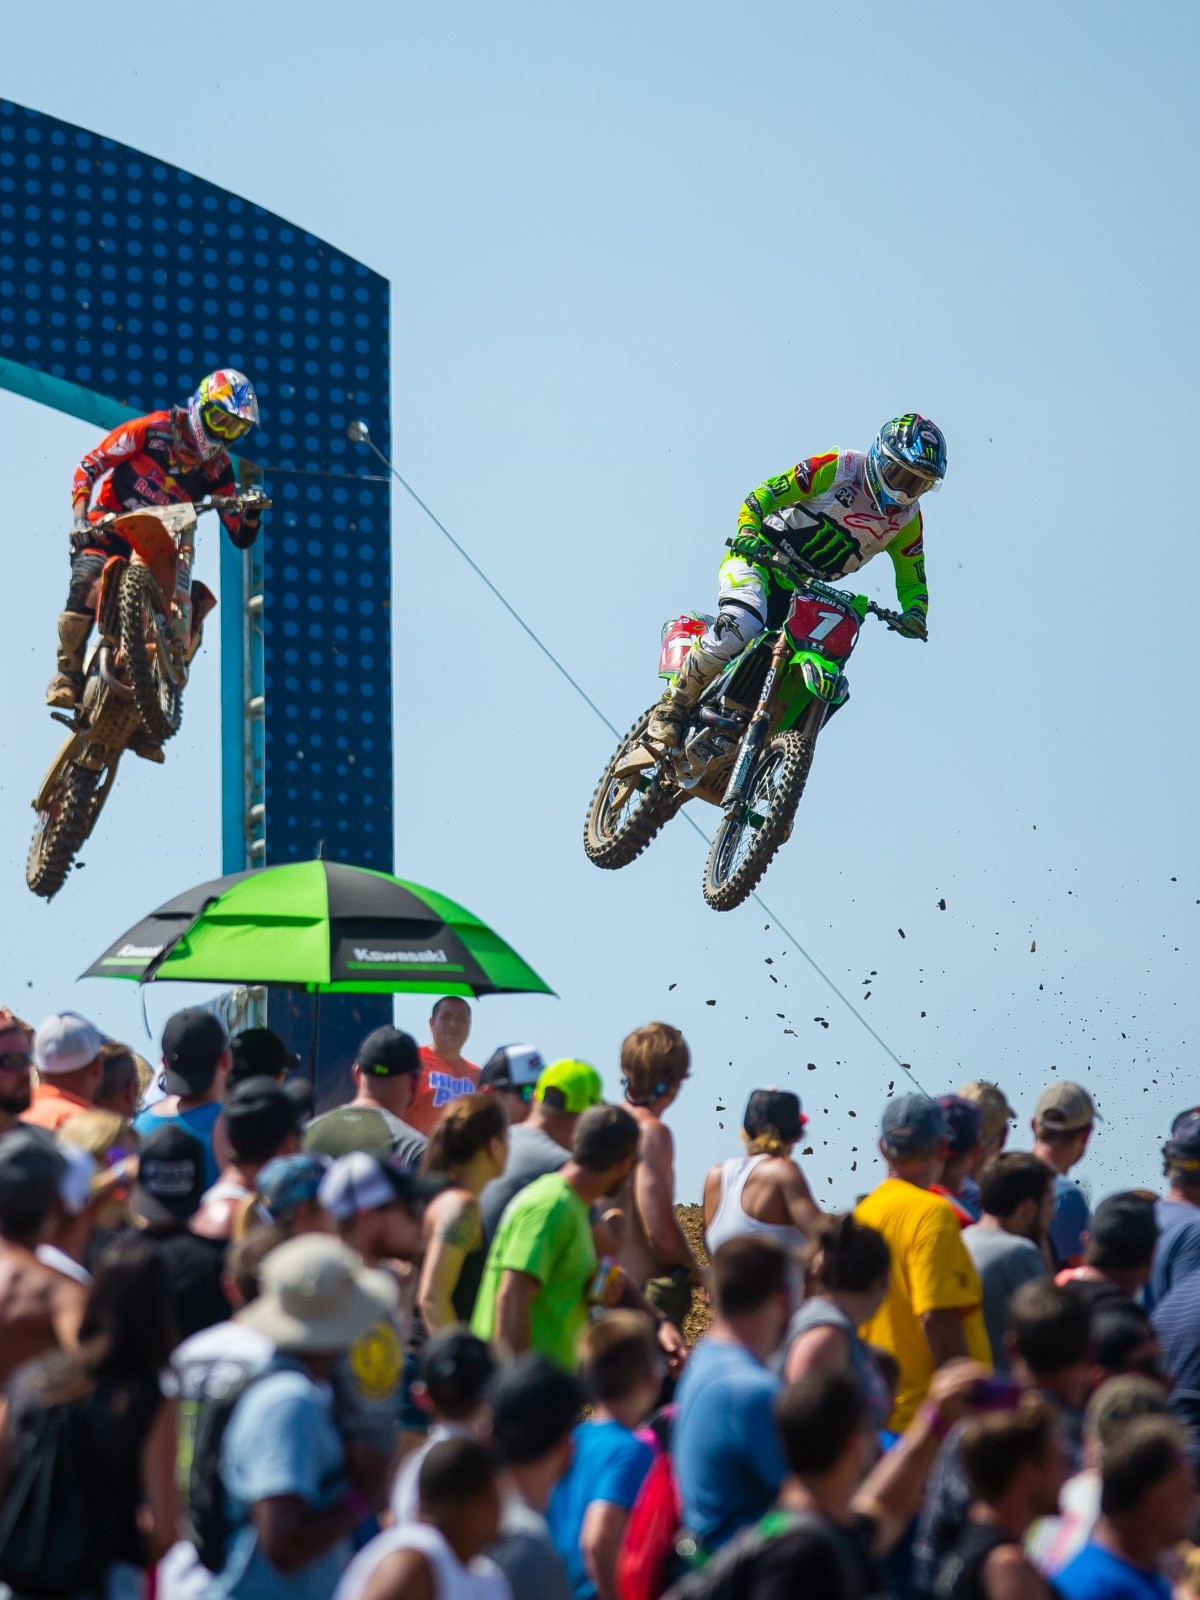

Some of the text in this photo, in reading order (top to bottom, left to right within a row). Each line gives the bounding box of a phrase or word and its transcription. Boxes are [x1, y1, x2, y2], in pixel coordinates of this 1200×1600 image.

[816, 596, 846, 613] LUCAS OIL
[808, 611, 844, 641] 1
[353, 948, 448, 963] Kawasaki
[429, 1071, 475, 1096] High
